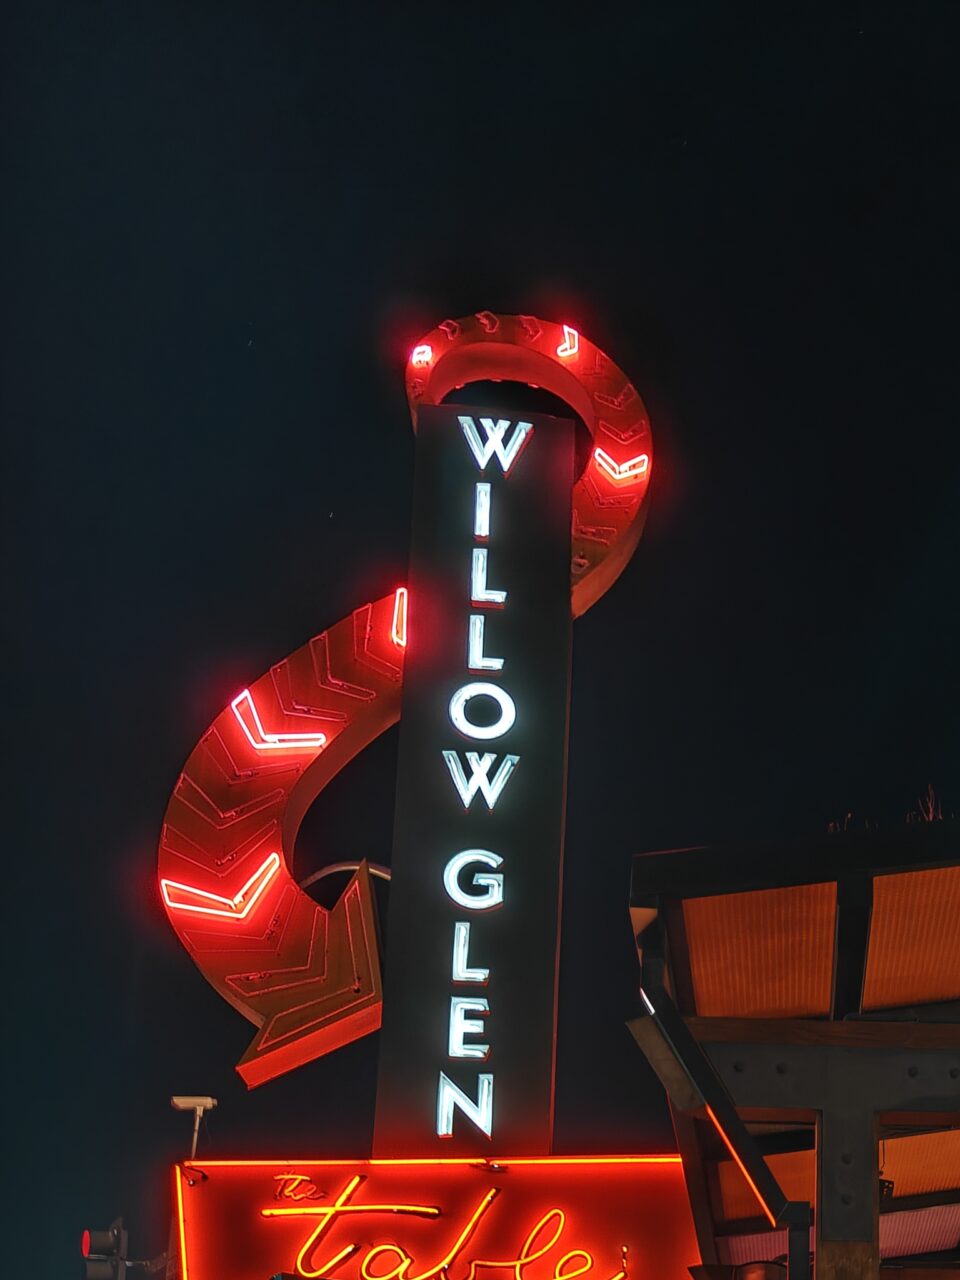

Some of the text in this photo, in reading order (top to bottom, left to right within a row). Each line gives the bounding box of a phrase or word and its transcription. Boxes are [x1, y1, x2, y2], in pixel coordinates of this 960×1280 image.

[435, 414, 534, 1142] WILLOW GLEN
[273, 1174, 326, 1201] The
